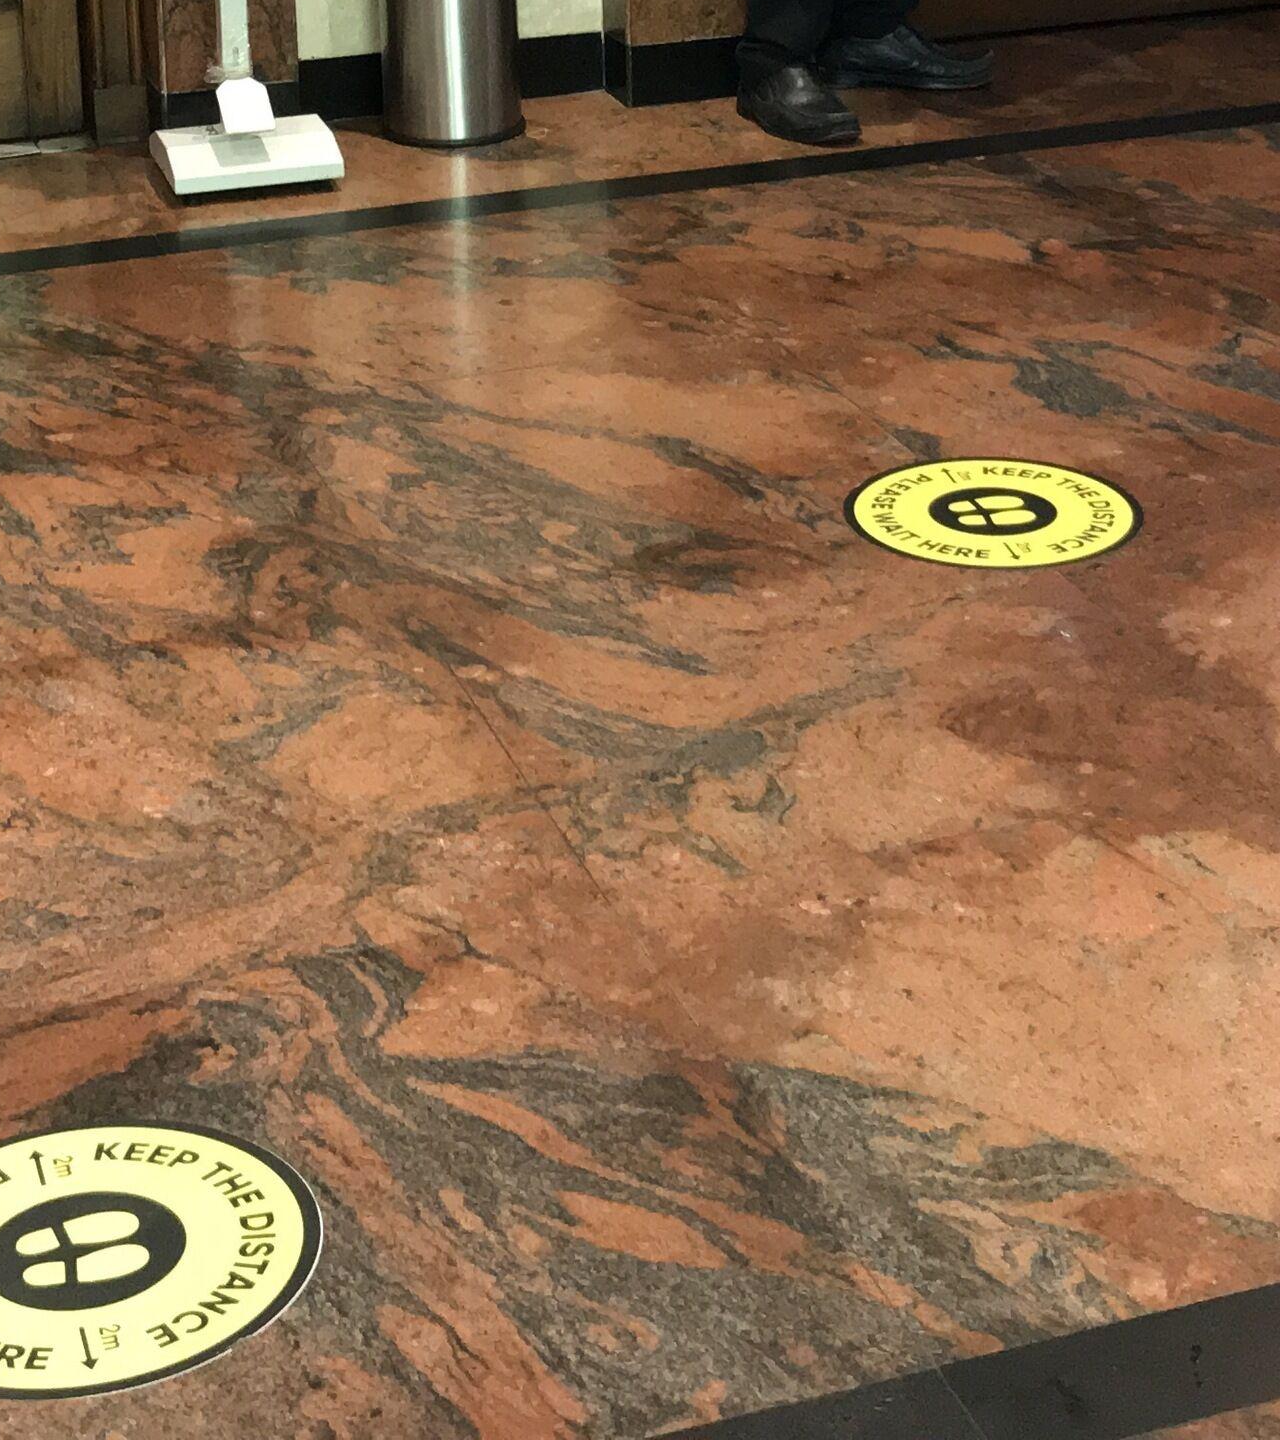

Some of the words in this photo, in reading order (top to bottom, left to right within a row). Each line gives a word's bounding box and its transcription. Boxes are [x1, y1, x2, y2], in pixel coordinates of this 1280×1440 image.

[982, 466, 1052, 481] KEEP
[1058, 477, 1100, 500] THE
[870, 472, 934, 510] PLEASE
[871, 512, 922, 542] WAIT
[1045, 499, 1117, 554] DISTANCE
[916, 539, 992, 560] HERE
[52, 1154, 74, 1179] 2m
[94, 1141, 200, 1169] KEEP
[200, 1161, 266, 1209] THE
[144, 1211, 277, 1349] DISTANCE
[98, 1322, 122, 1353] 2m
